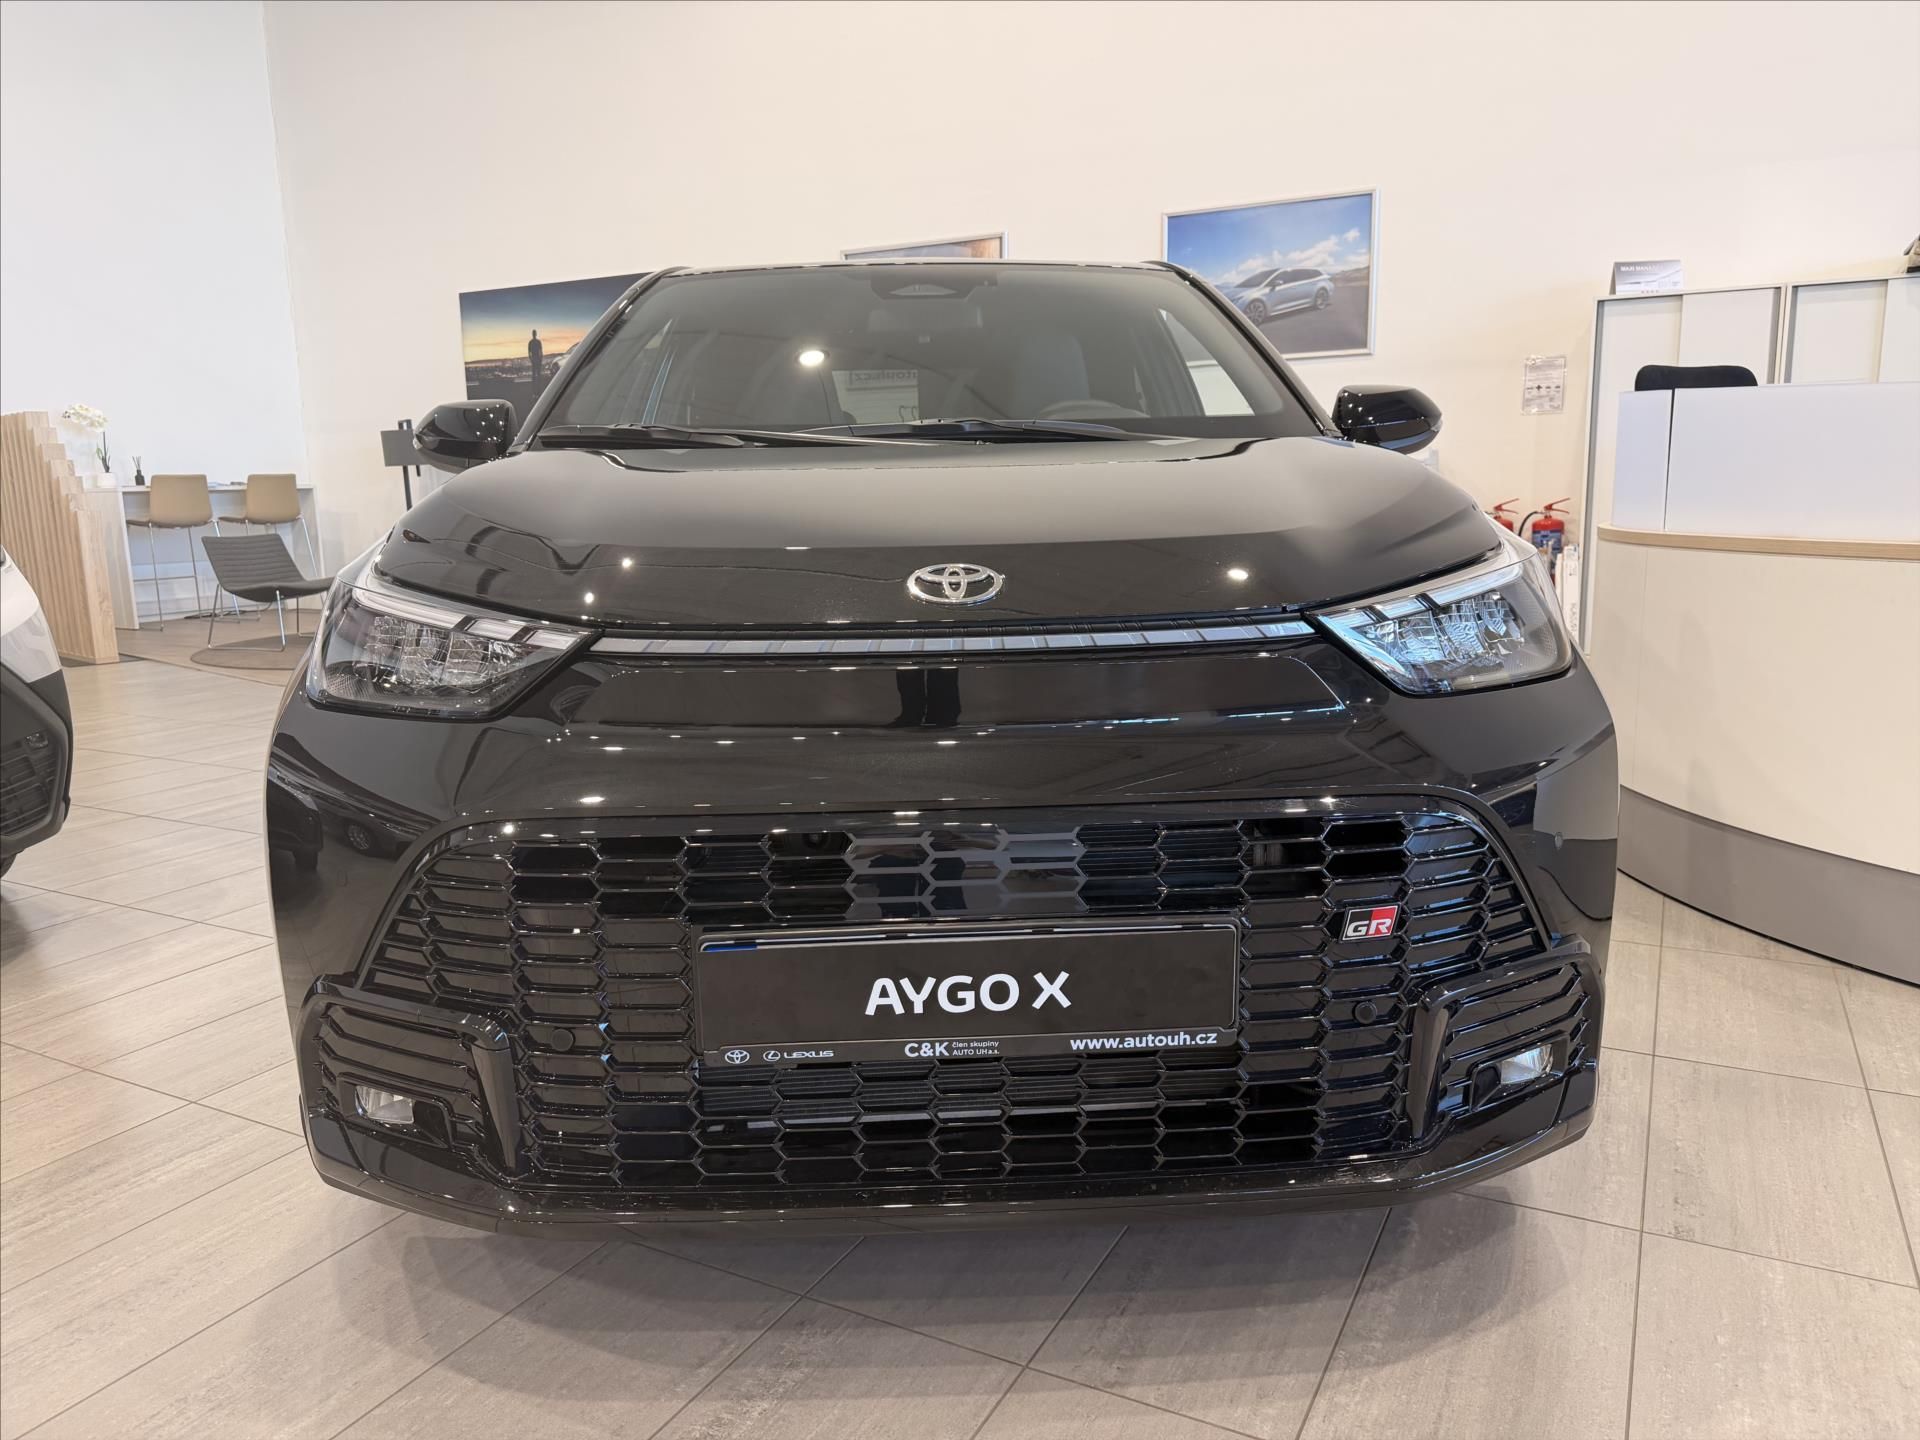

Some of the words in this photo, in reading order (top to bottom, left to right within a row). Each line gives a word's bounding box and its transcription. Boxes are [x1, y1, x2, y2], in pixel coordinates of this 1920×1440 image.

[1346, 918, 1392, 937] GR
[864, 973, 1020, 1016] AYGO
[1031, 970, 1072, 1010] X
[904, 1041, 950, 1058] C&K
[969, 1040, 1000, 1048] skupiny
[1070, 1031, 1218, 1050] www.autouh.cz
[784, 1050, 835, 1059] LEXUS
